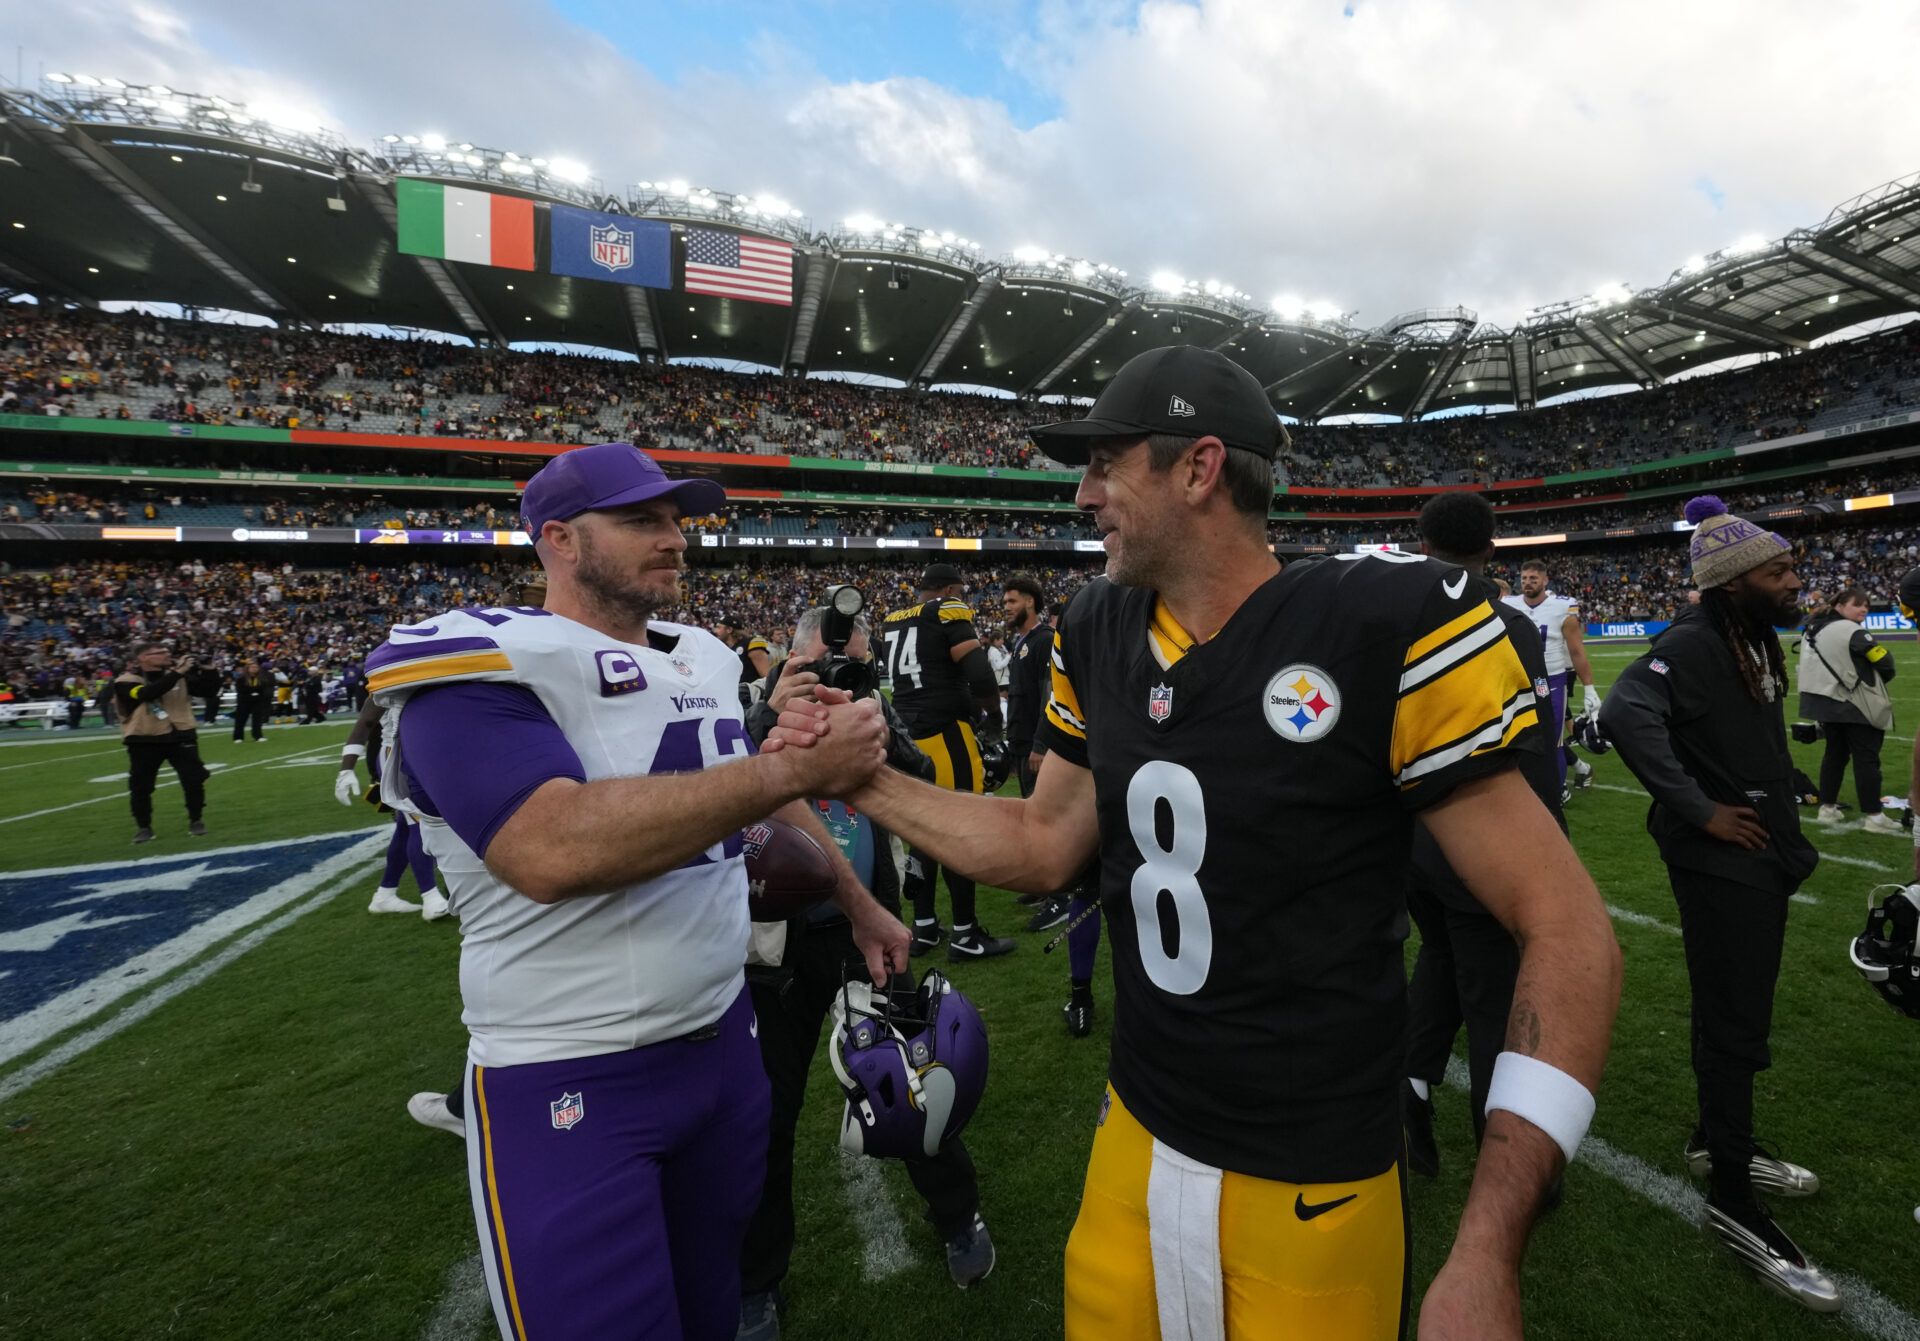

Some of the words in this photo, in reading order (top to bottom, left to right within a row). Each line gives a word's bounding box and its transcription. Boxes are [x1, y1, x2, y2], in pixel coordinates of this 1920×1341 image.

[597, 243, 628, 265] NFL
[442, 532, 459, 543] 21
[738, 537, 756, 545] 2ND
[757, 537, 764, 545] &
[765, 537, 774, 545] 11
[822, 538, 834, 547] 33
[1601, 622, 1645, 636] LOWE'S
[1860, 613, 1912, 630] WE'S
[600, 652, 640, 683] C
[884, 627, 923, 693] 74
[1152, 701, 1168, 715] NFL
[1270, 694, 1300, 707] Steelers
[1126, 760, 1213, 996] 8
[557, 1106, 580, 1124] NFL
